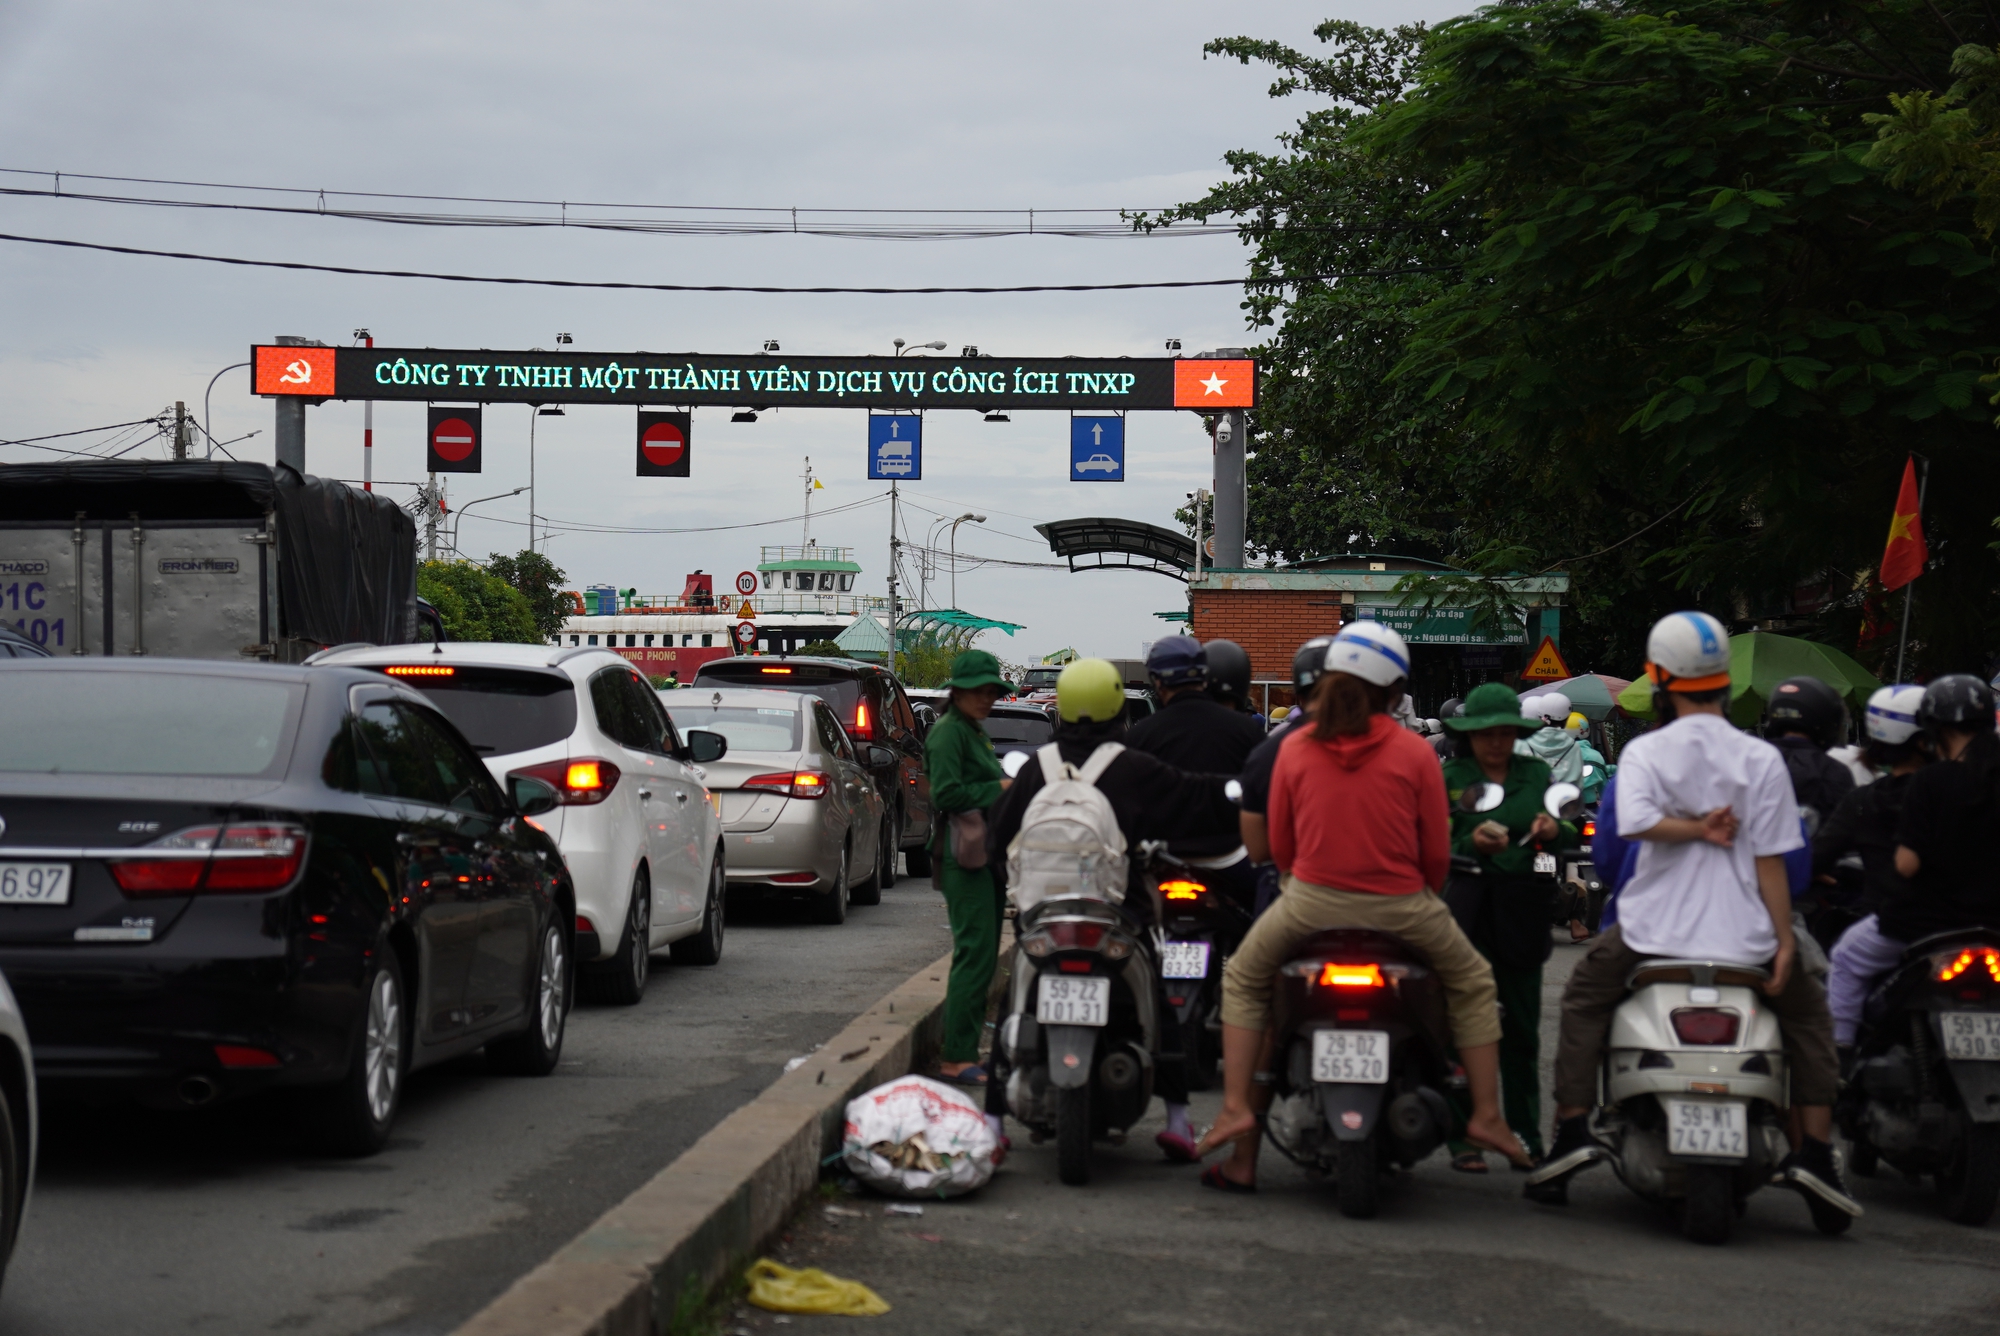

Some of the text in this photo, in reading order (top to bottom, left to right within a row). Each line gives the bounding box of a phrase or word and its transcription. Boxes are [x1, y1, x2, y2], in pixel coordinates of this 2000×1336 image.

[375, 358, 1136, 398] CÔNG TY TNHH MỘT THÀNH VIÊN DỊCH VỤ CÔNG ÍCH TNXP
[162, 561, 235, 571] FRONTIER
[1382, 608, 1407, 618] Người
[1435, 609, 1446, 618] Xe
[1448, 609, 1464, 619] đạp
[1394, 621, 1413, 630] máy
[1422, 633, 1448, 642] Người
[646, 650, 677, 661] PHONG
[1535, 666, 1559, 677] CHẬM
[1165, 961, 1202, 976] 93.25
[1050, 980, 1098, 1001] 59-Z2
[1043, 1001, 1100, 1022] 101.31
[1319, 1057, 1382, 1078] 565.20
[1674, 1128, 1742, 1153] 747.42
